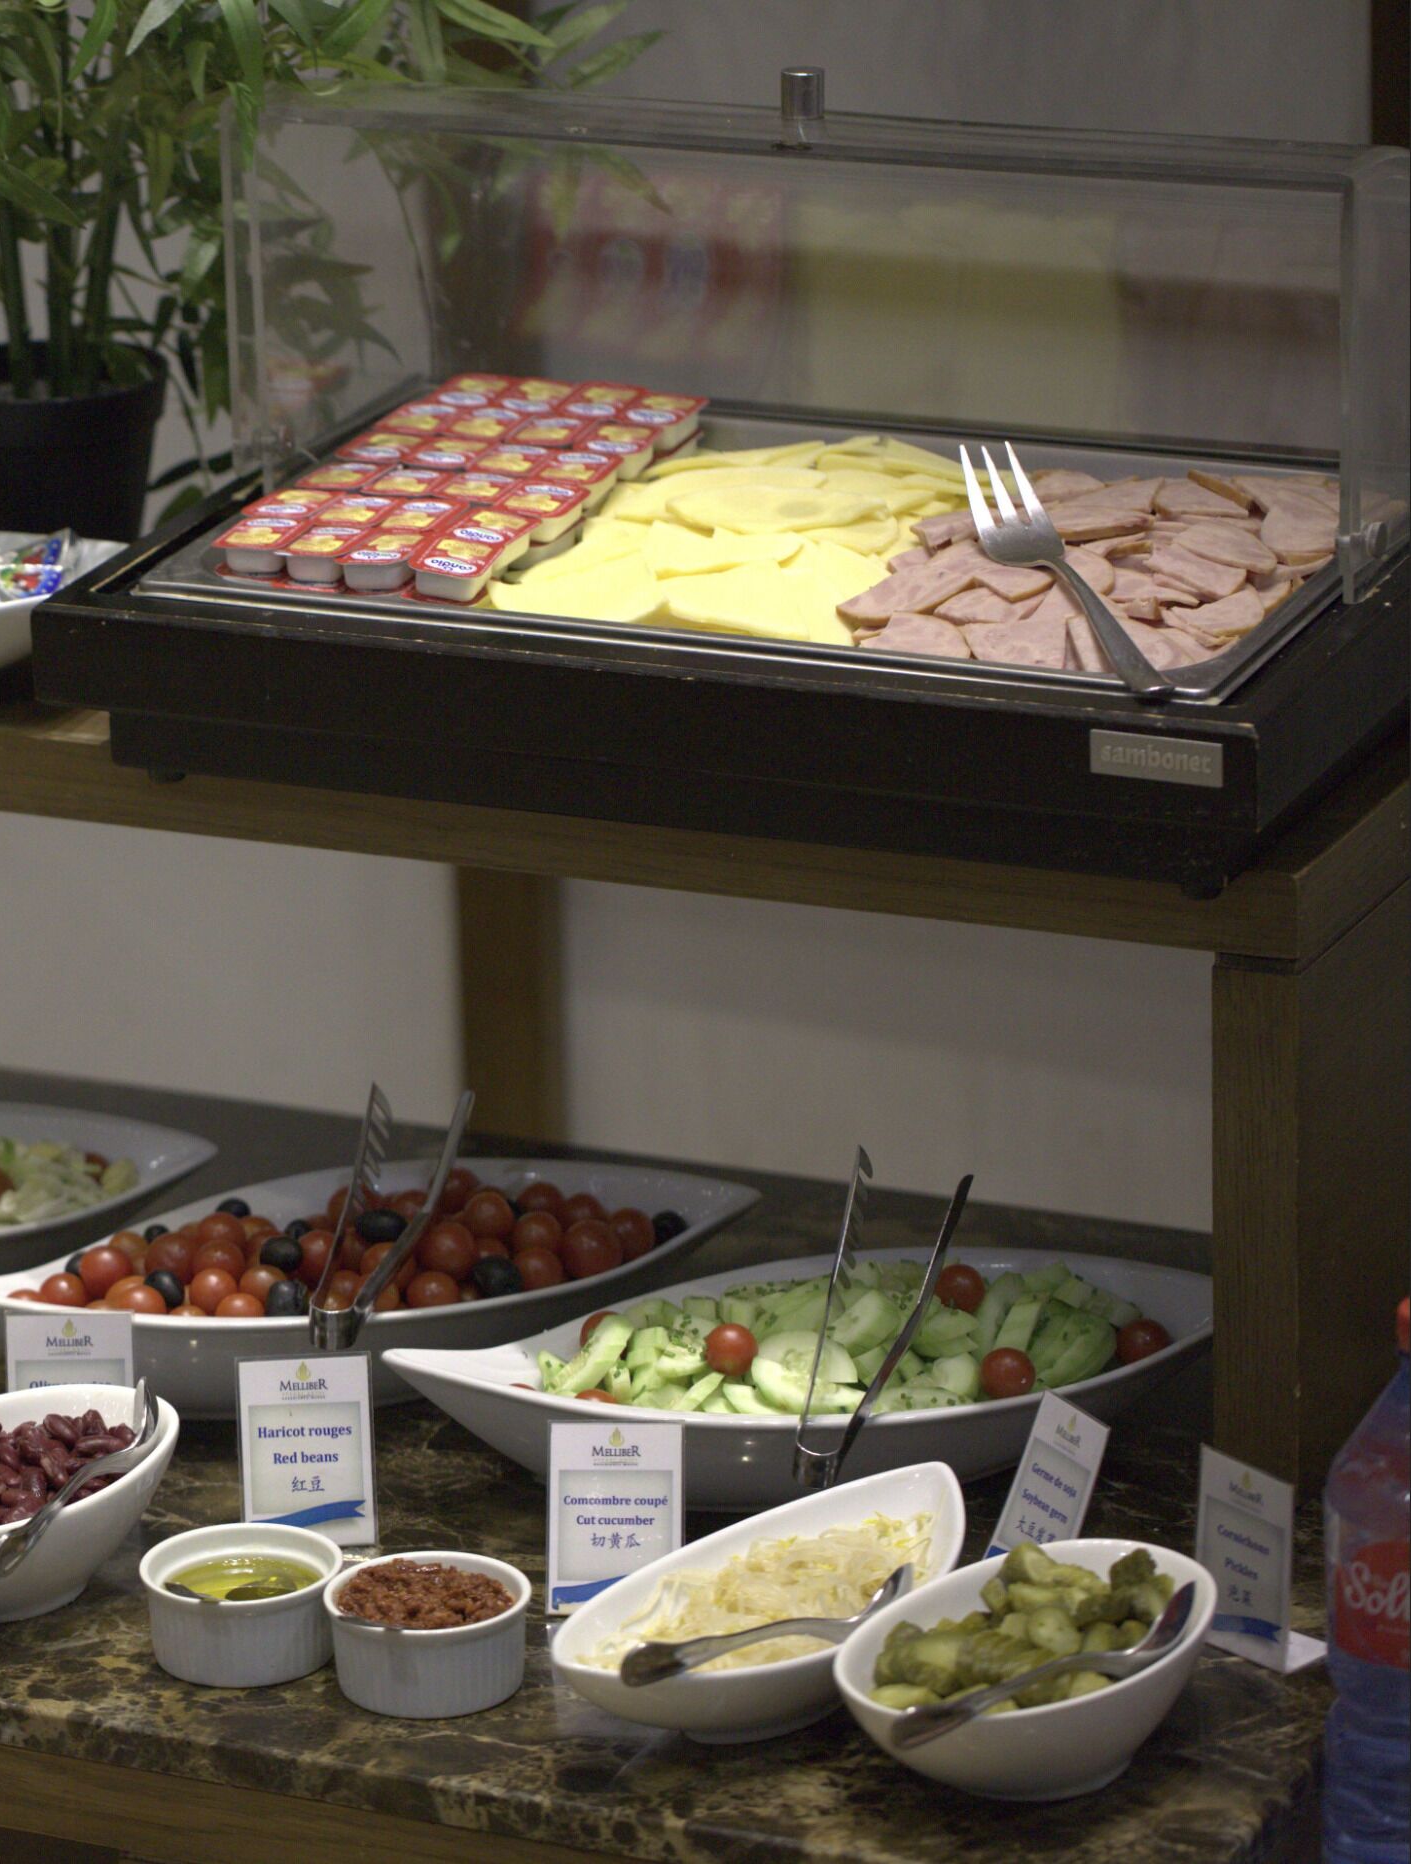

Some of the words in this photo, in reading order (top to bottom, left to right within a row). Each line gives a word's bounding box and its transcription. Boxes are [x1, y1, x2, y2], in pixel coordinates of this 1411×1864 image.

[1101, 744, 1212, 773] sambonet
[258, 1426, 305, 1439] Haricot
[309, 1425, 352, 1439] rouges
[273, 1452, 297, 1465] Red
[301, 1451, 339, 1464] beans
[1032, 1462, 1054, 1484] Germe
[1054, 1478, 1062, 1489] de
[563, 1495, 632, 1506] Comcombre
[634, 1495, 668, 1508] coupé
[1021, 1488, 1049, 1513] Soybean
[1050, 1506, 1069, 1525] germ
[576, 1515, 596, 1526] Cut
[598, 1515, 655, 1525] cucumber
[591, 1532, 640, 1549] 切黄瓜
[1344, 1562, 1410, 1620] Sol
